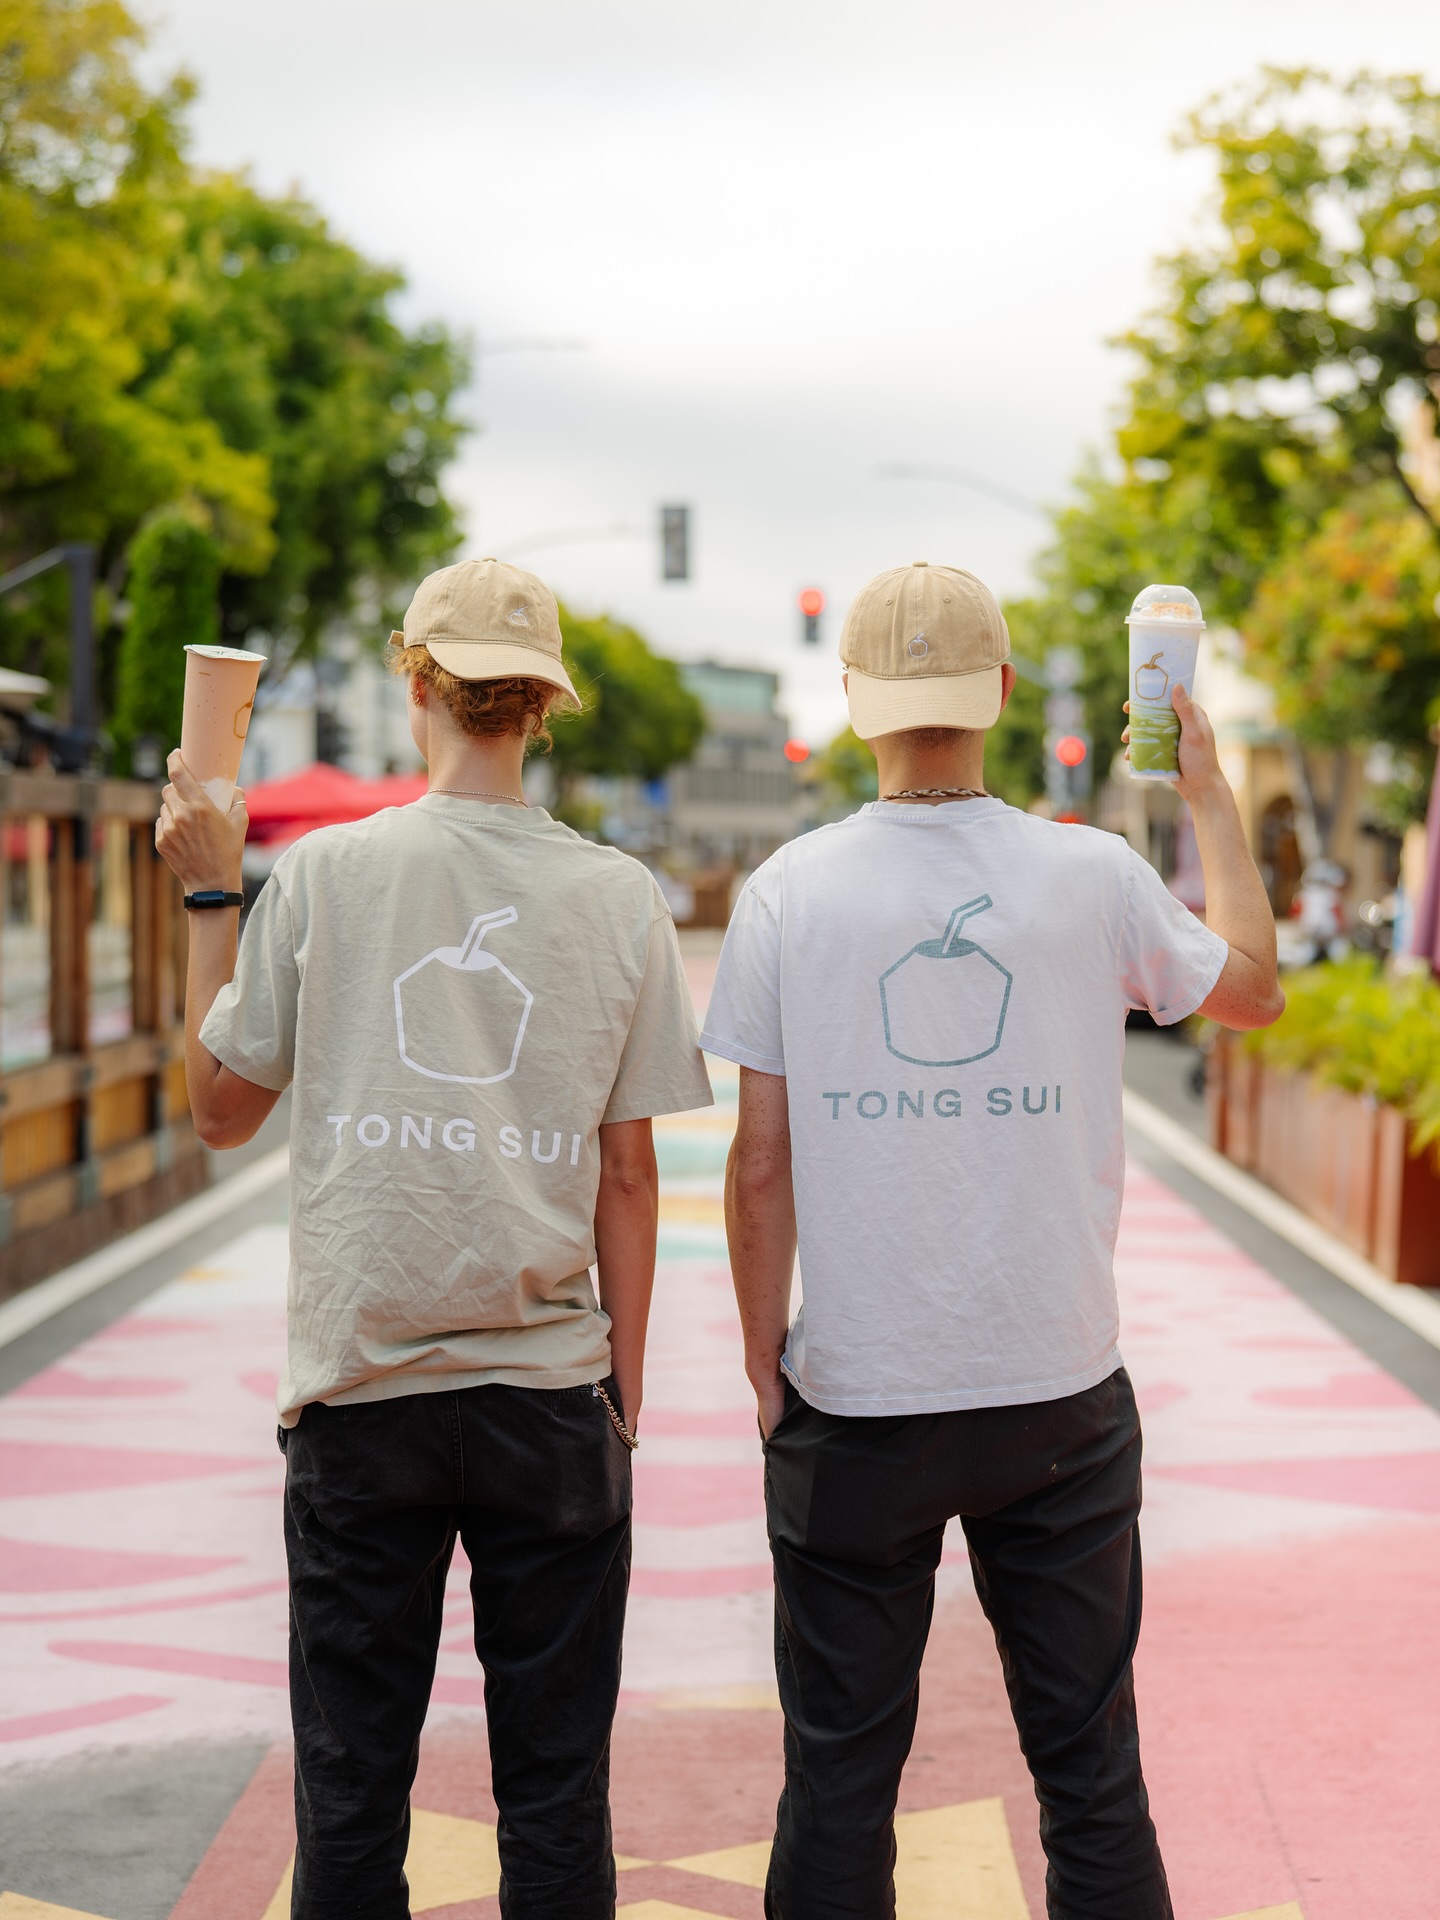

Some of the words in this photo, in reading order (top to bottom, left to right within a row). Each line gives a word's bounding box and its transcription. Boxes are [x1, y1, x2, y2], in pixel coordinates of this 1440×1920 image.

[822, 1089, 962, 1120] TONG
[986, 1085, 1061, 1116] SUI
[326, 1114, 477, 1151] TONG
[498, 1126, 581, 1166] SUI
